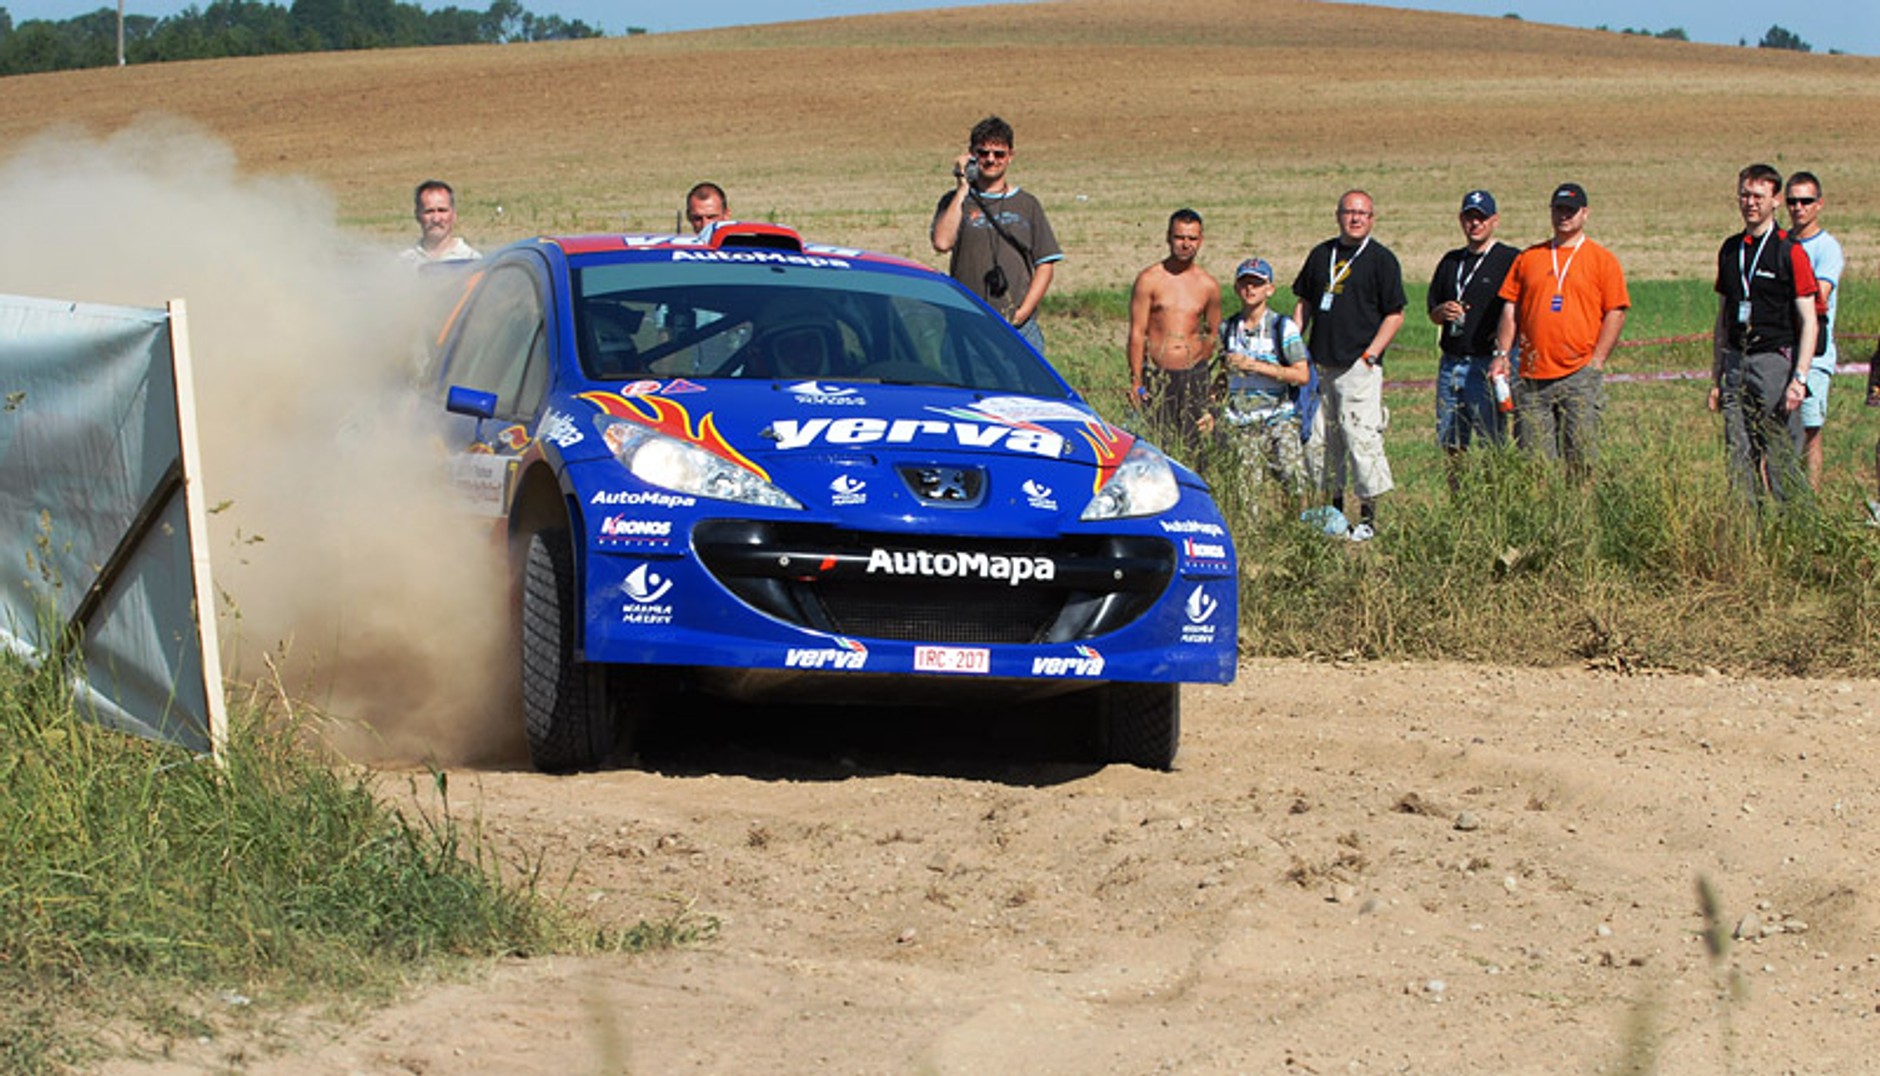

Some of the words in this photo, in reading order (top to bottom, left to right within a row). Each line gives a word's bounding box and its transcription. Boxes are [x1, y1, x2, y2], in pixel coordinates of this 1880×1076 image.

[672, 250, 850, 269] AutoMapa
[772, 418, 1064, 459] verva
[590, 490, 697, 508] AutoMapa
[601, 513, 672, 536] KRONOS
[866, 548, 1055, 586] AutoMapa
[785, 648, 868, 669] verva
[918, 648, 986, 669] IRC-207
[1032, 656, 1105, 676] verva
